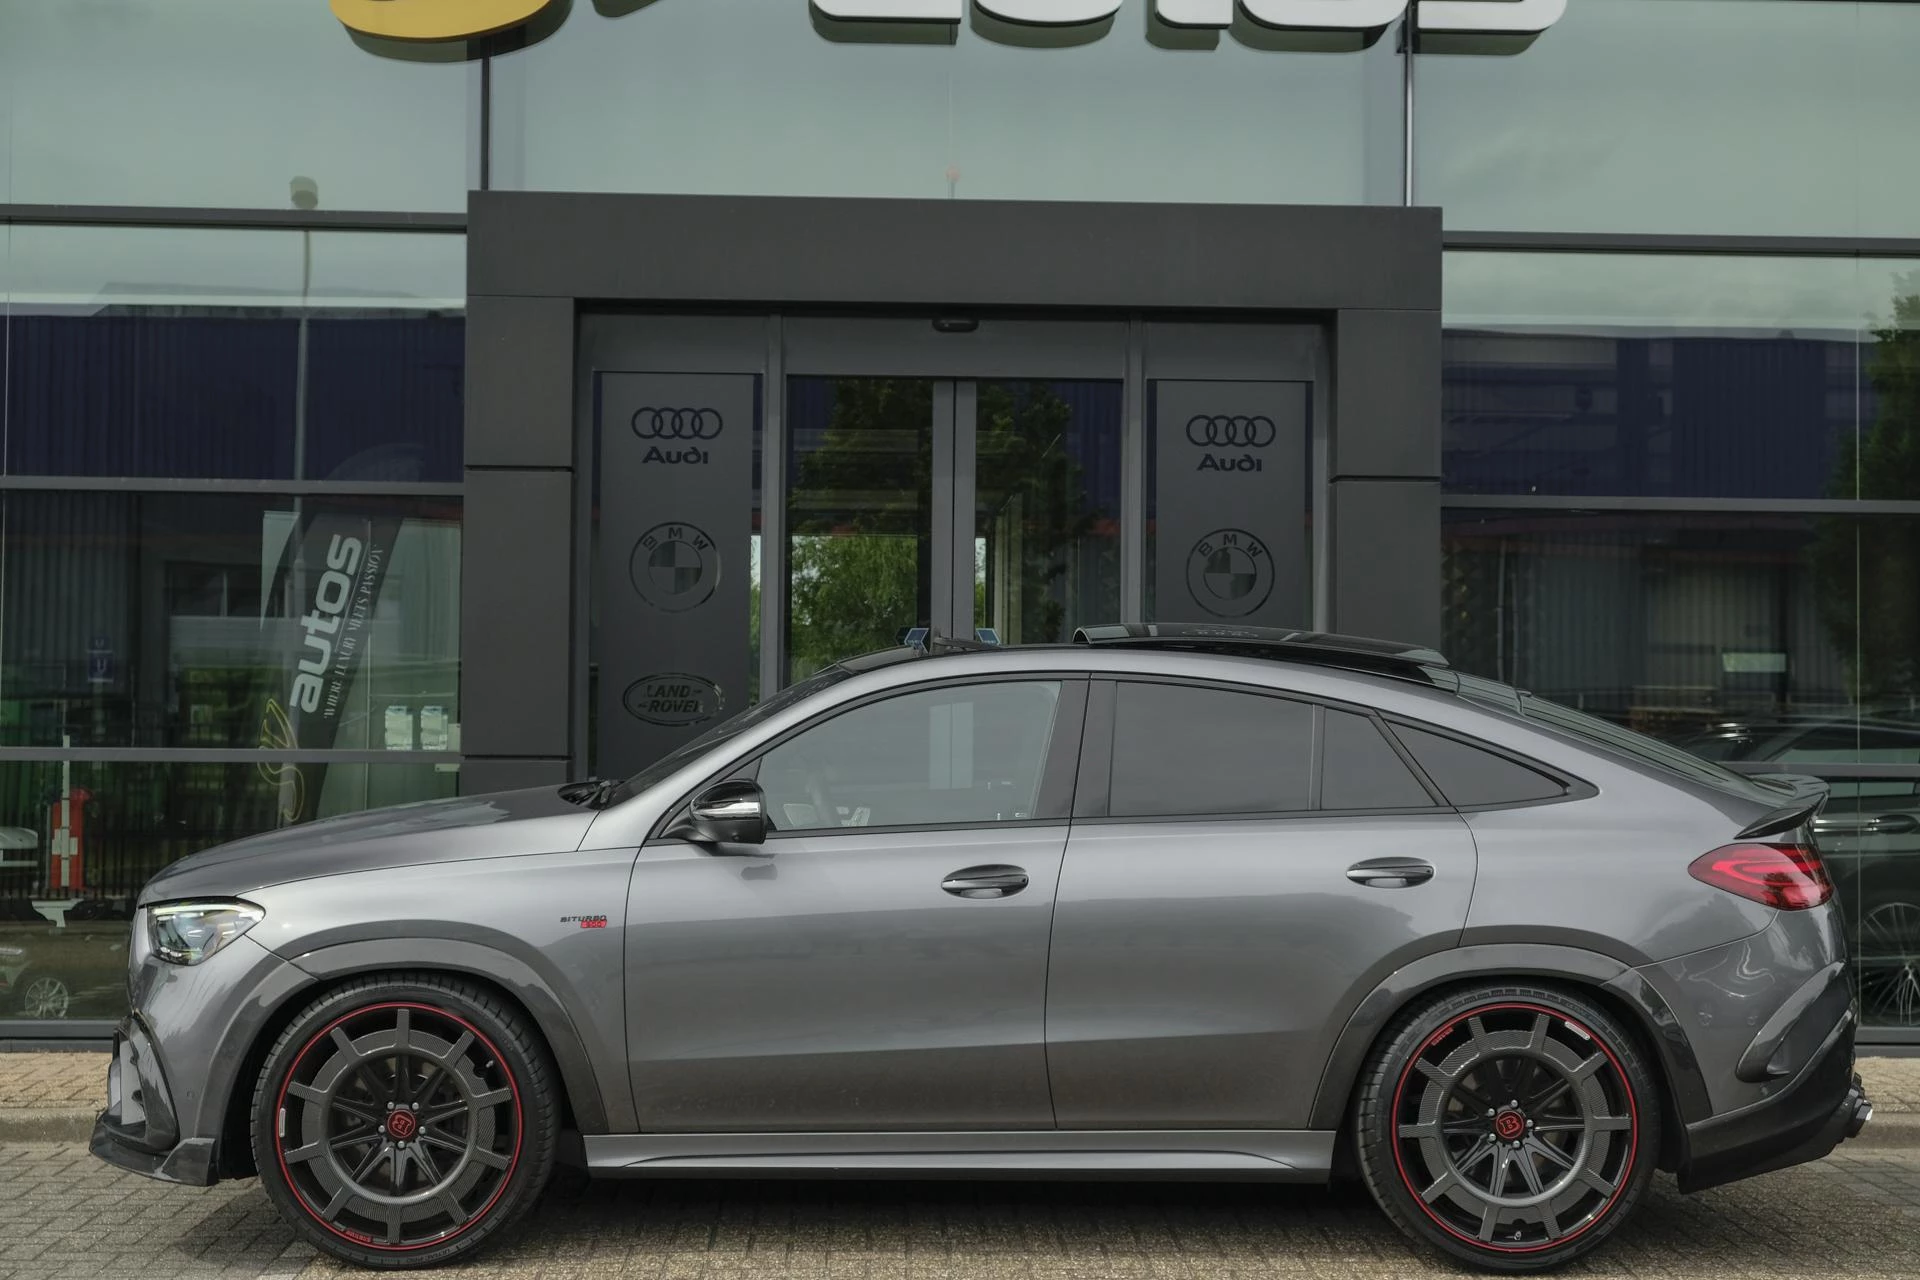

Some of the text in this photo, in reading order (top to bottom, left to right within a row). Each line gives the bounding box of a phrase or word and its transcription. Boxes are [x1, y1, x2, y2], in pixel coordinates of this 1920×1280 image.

[641, 446, 709, 465] Audi
[1196, 454, 1262, 472] Audi
[643, 527, 708, 551] BMW
[1198, 533, 1263, 558] BMW
[290, 534, 362, 713] autos
